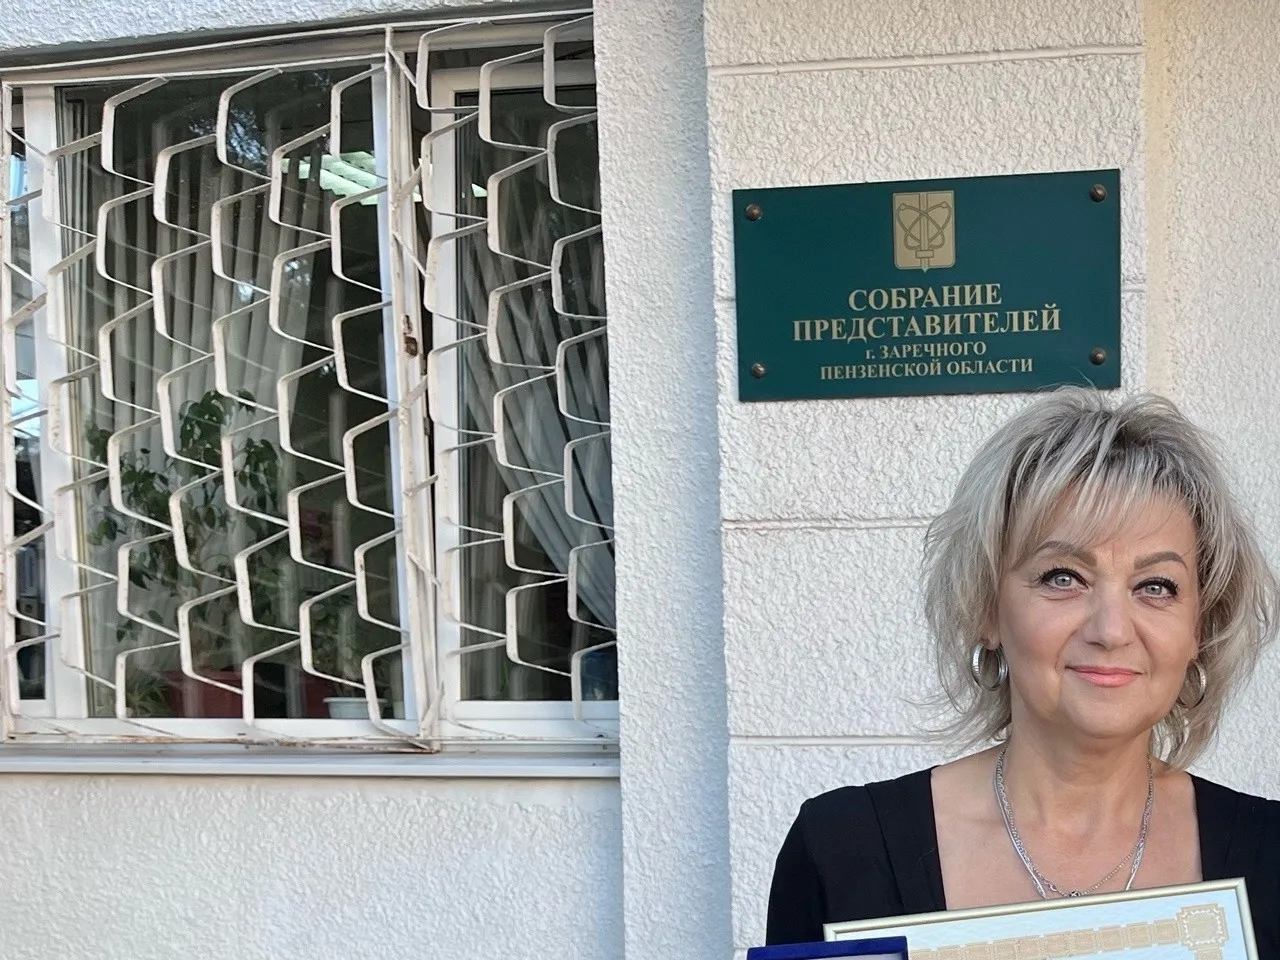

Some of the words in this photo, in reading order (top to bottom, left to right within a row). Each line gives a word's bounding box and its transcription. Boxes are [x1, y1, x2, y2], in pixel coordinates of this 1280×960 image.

[848, 283, 1002, 312] СОБРАНИЕ
[793, 303, 1061, 344] ПРЕДСТАВИТЕЛЕЙ
[865, 349, 876, 360] г.
[879, 341, 987, 358] ЗАРЕЧНОГО
[820, 358, 942, 380] ПЕНЗЕНСКОЙ
[947, 358, 1033, 377] ОБЛАСТИ
